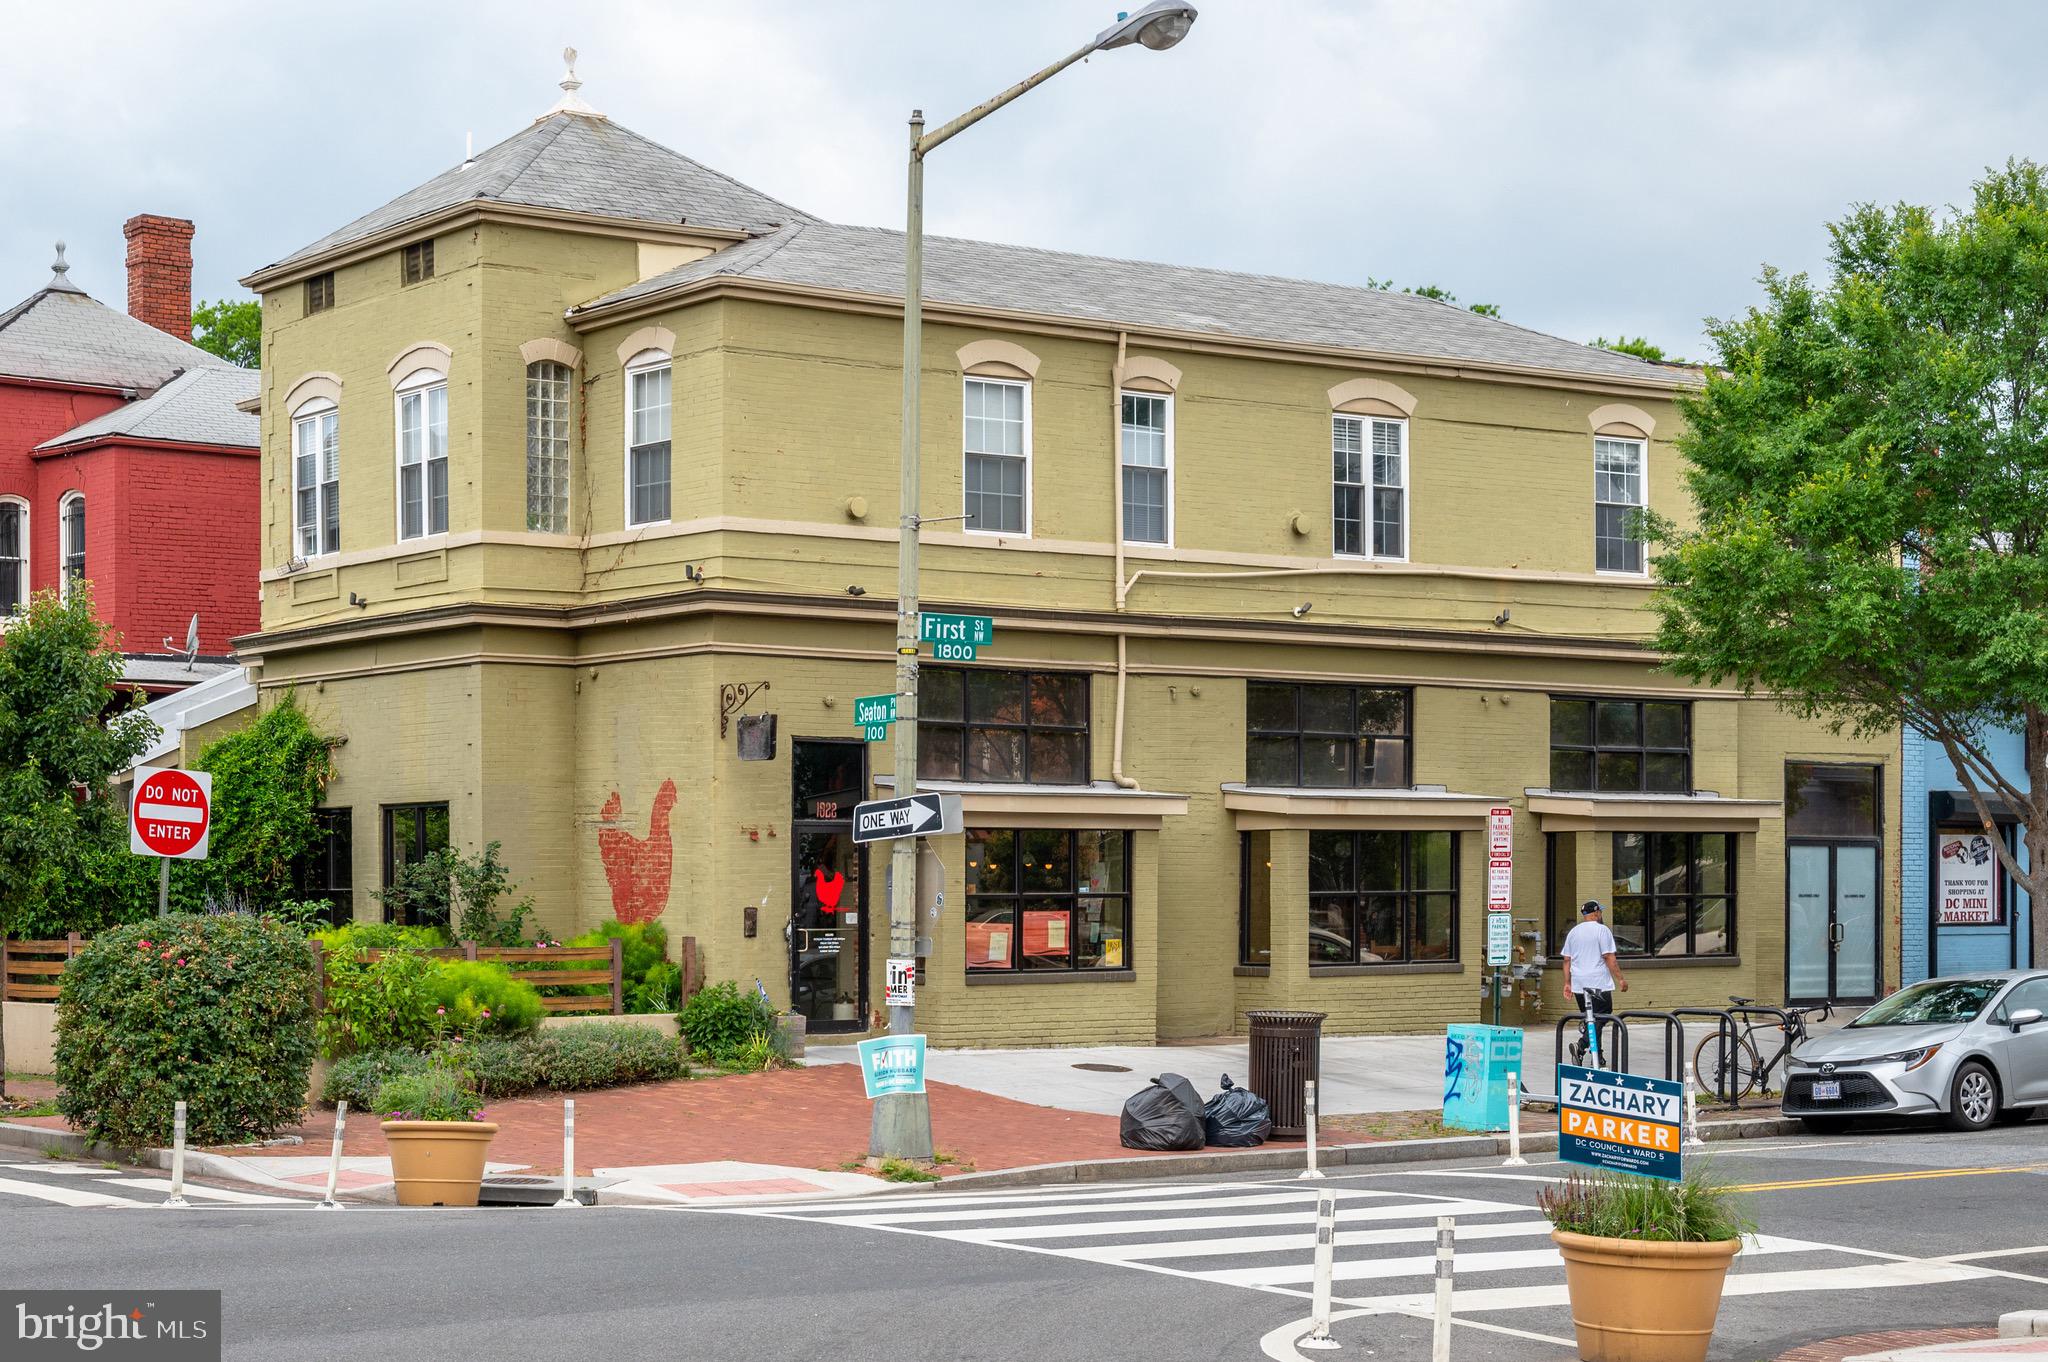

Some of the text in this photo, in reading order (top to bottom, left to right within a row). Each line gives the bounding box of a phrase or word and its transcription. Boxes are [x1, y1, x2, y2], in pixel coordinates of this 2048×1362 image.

[925, 617, 984, 640] First St
[974, 631, 984, 642] NW
[937, 644, 973, 660] 1800
[858, 702, 887, 722] Seaton
[867, 726, 884, 740] 100
[146, 785, 199, 803] DO NOT
[862, 809, 911, 829] ONE WAY
[1498, 816, 1504, 824] NO
[148, 823, 191, 840] ENTER
[1945, 899, 1988, 909] DC MINI
[1944, 912, 1989, 922] MARKET
[871, 1048, 917, 1072] FAITH
[1569, 1082, 1670, 1117] ZACHARY
[1568, 1112, 1669, 1149] PARKER
[1575, 1138, 1665, 1161] DC COUNCIL WARD 5
